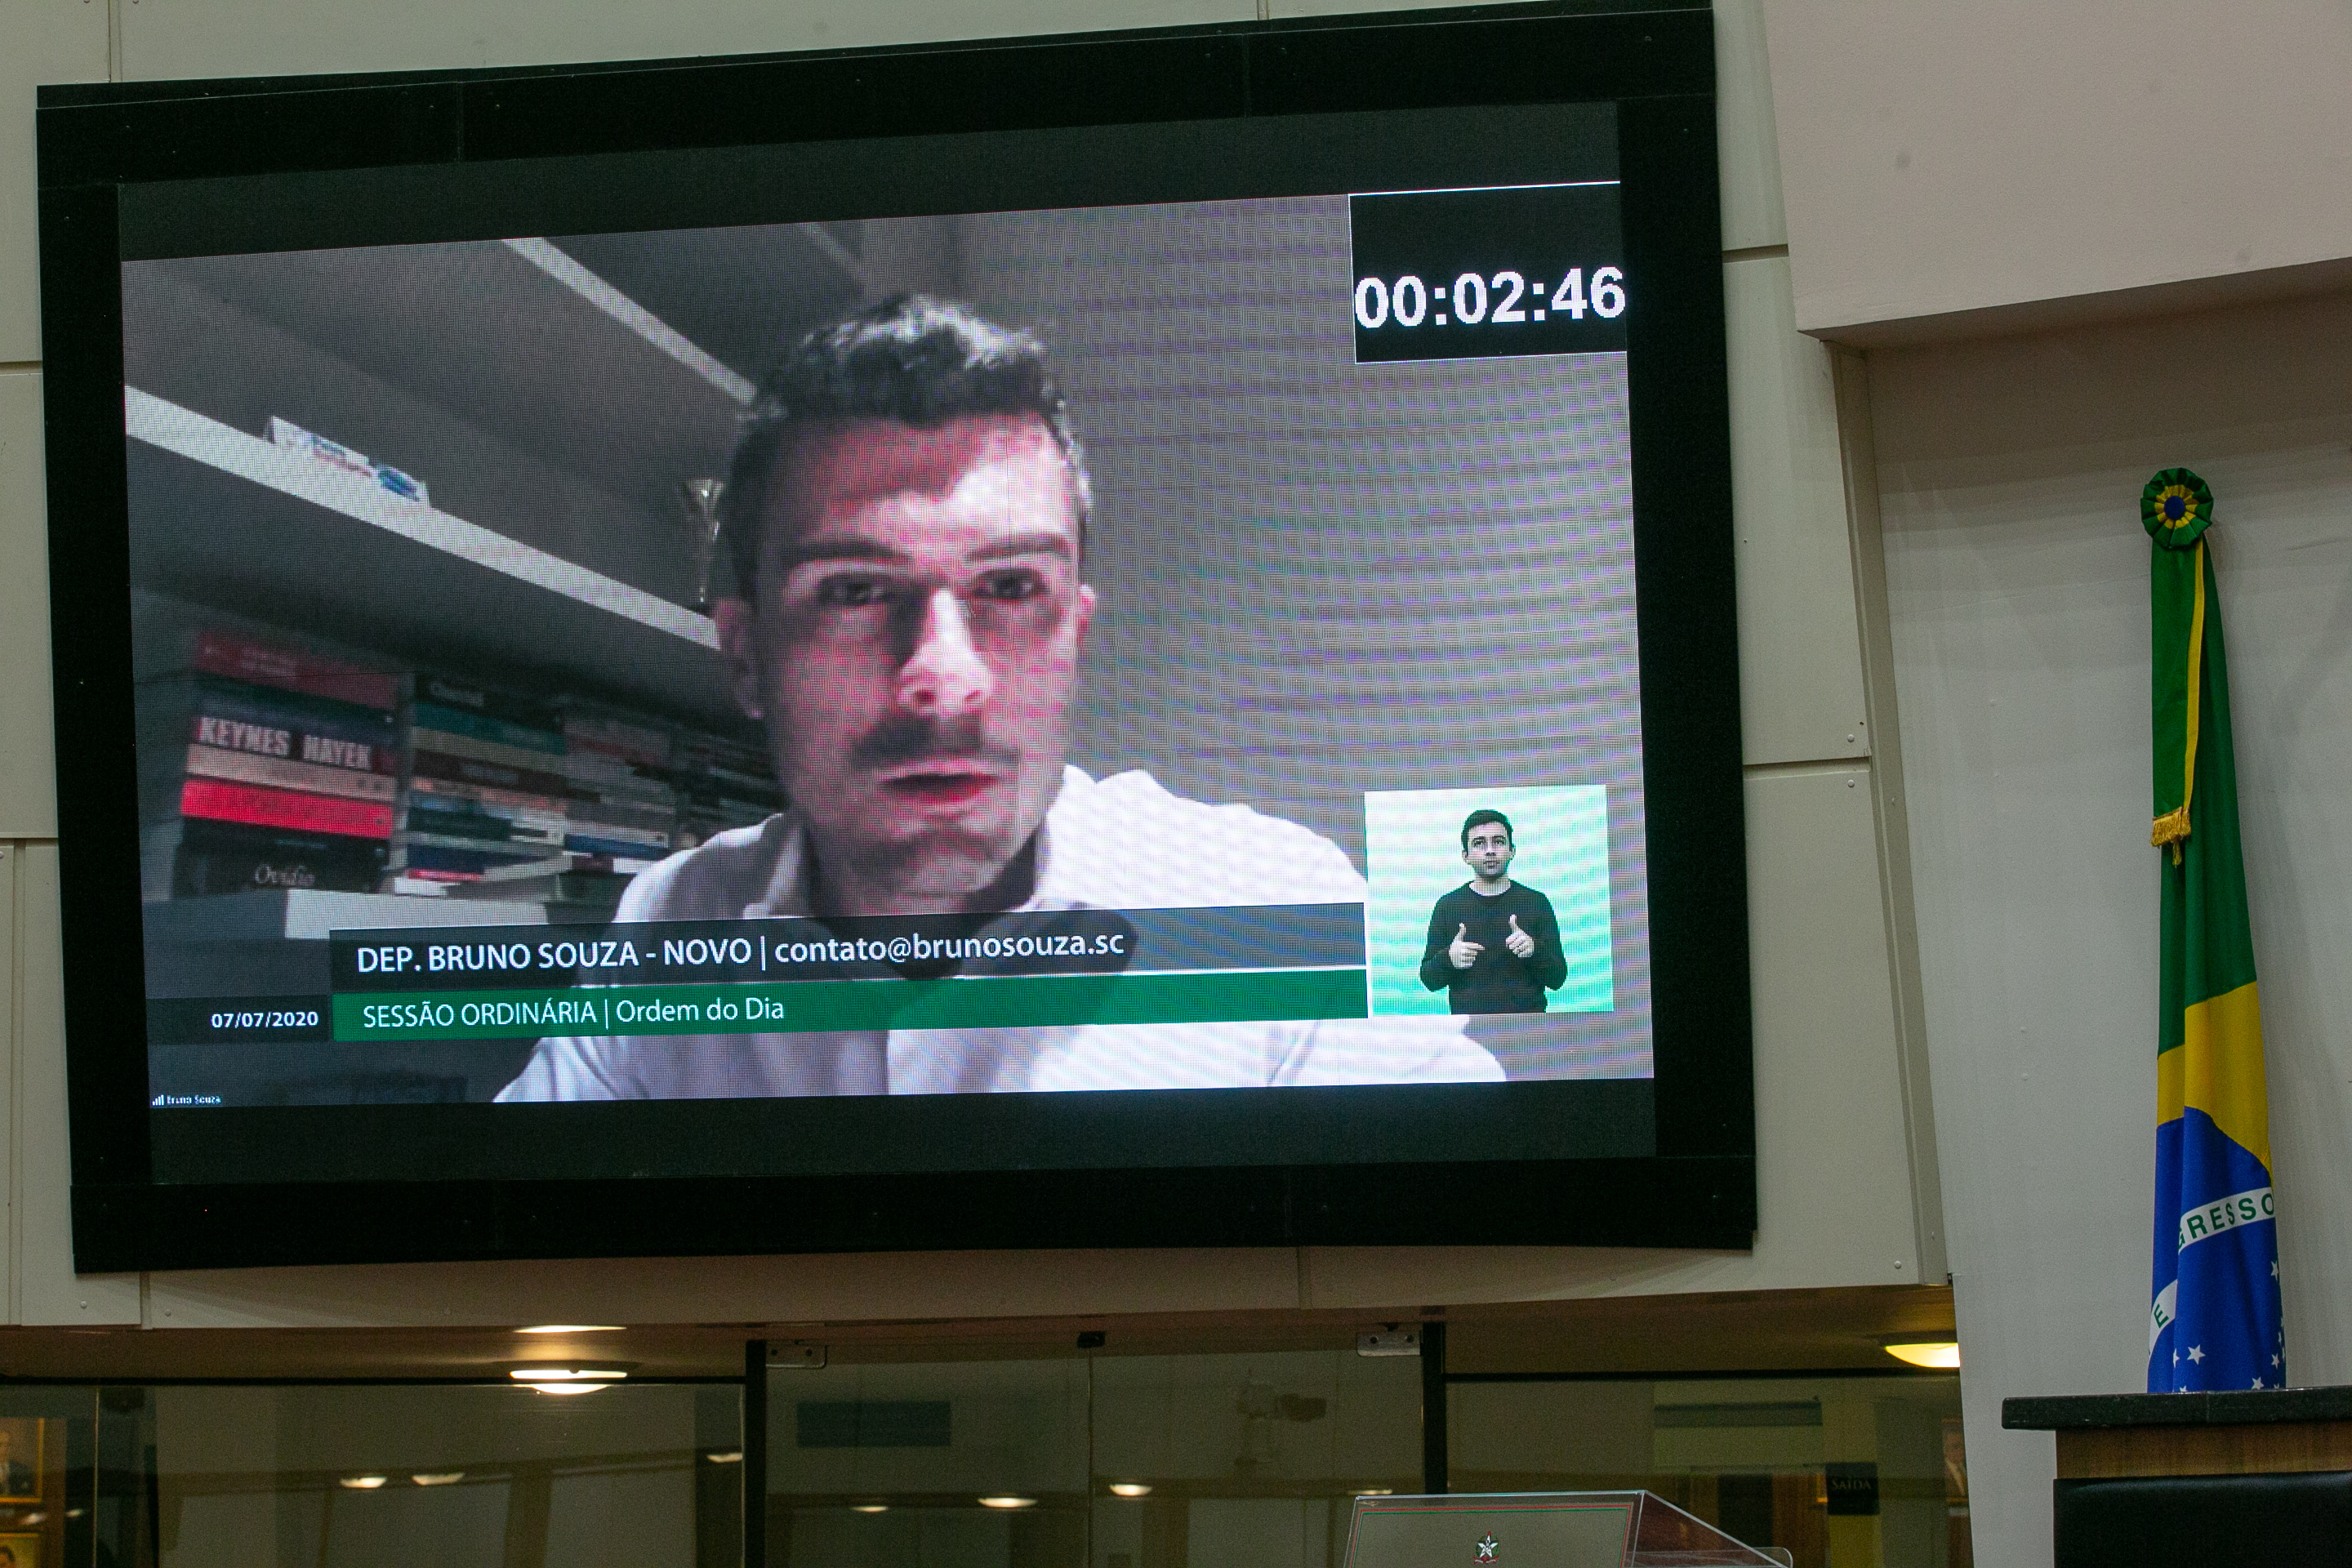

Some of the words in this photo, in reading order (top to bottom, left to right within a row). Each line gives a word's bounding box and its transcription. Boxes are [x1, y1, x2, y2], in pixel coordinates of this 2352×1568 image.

[1354, 266, 1626, 329] 00:02:46
[198, 716, 291, 757] KEYNES
[358, 946, 421, 973] DEP.
[429, 943, 531, 971] BRUNO
[537, 940, 639, 969] SOUZA
[663, 938, 751, 966] NOVO
[774, 932, 1125, 964] contato@brunosouza.sc
[211, 1010, 319, 1029] 07/07/2020
[363, 1000, 455, 1029] SESSÃO
[461, 996, 598, 1027] ORDINÁRIA
[617, 997, 699, 1022] Ordem
[706, 996, 738, 1021] do
[746, 996, 785, 1021] Dia
